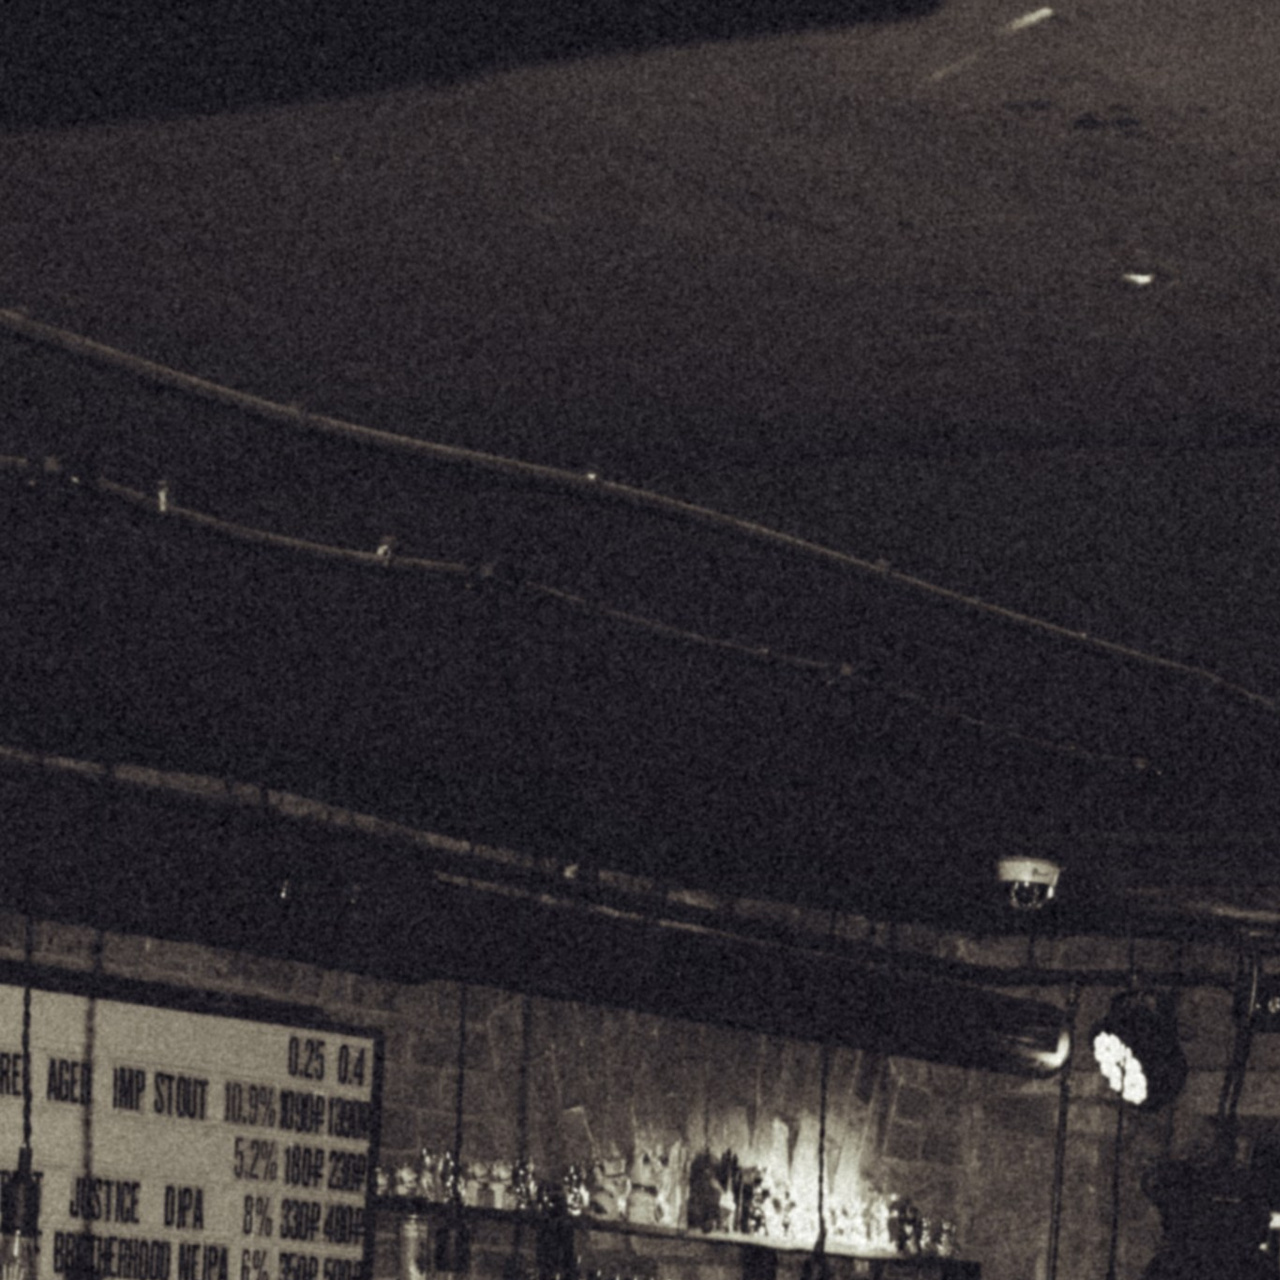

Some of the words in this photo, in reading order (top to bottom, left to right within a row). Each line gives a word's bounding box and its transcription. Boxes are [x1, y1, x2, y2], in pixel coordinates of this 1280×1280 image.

[289, 1036, 325, 1081] 0.25
[338, 1045, 365, 1087] 0.4
[113, 1066, 146, 1110] IMP
[154, 1071, 209, 1121] STOUT
[234, 1137, 278, 1182] 5.2%
[70, 1176, 140, 1224] JUSTICE
[164, 1184, 204, 1230] DIPA
[243, 1195, 273, 1237] 8%
